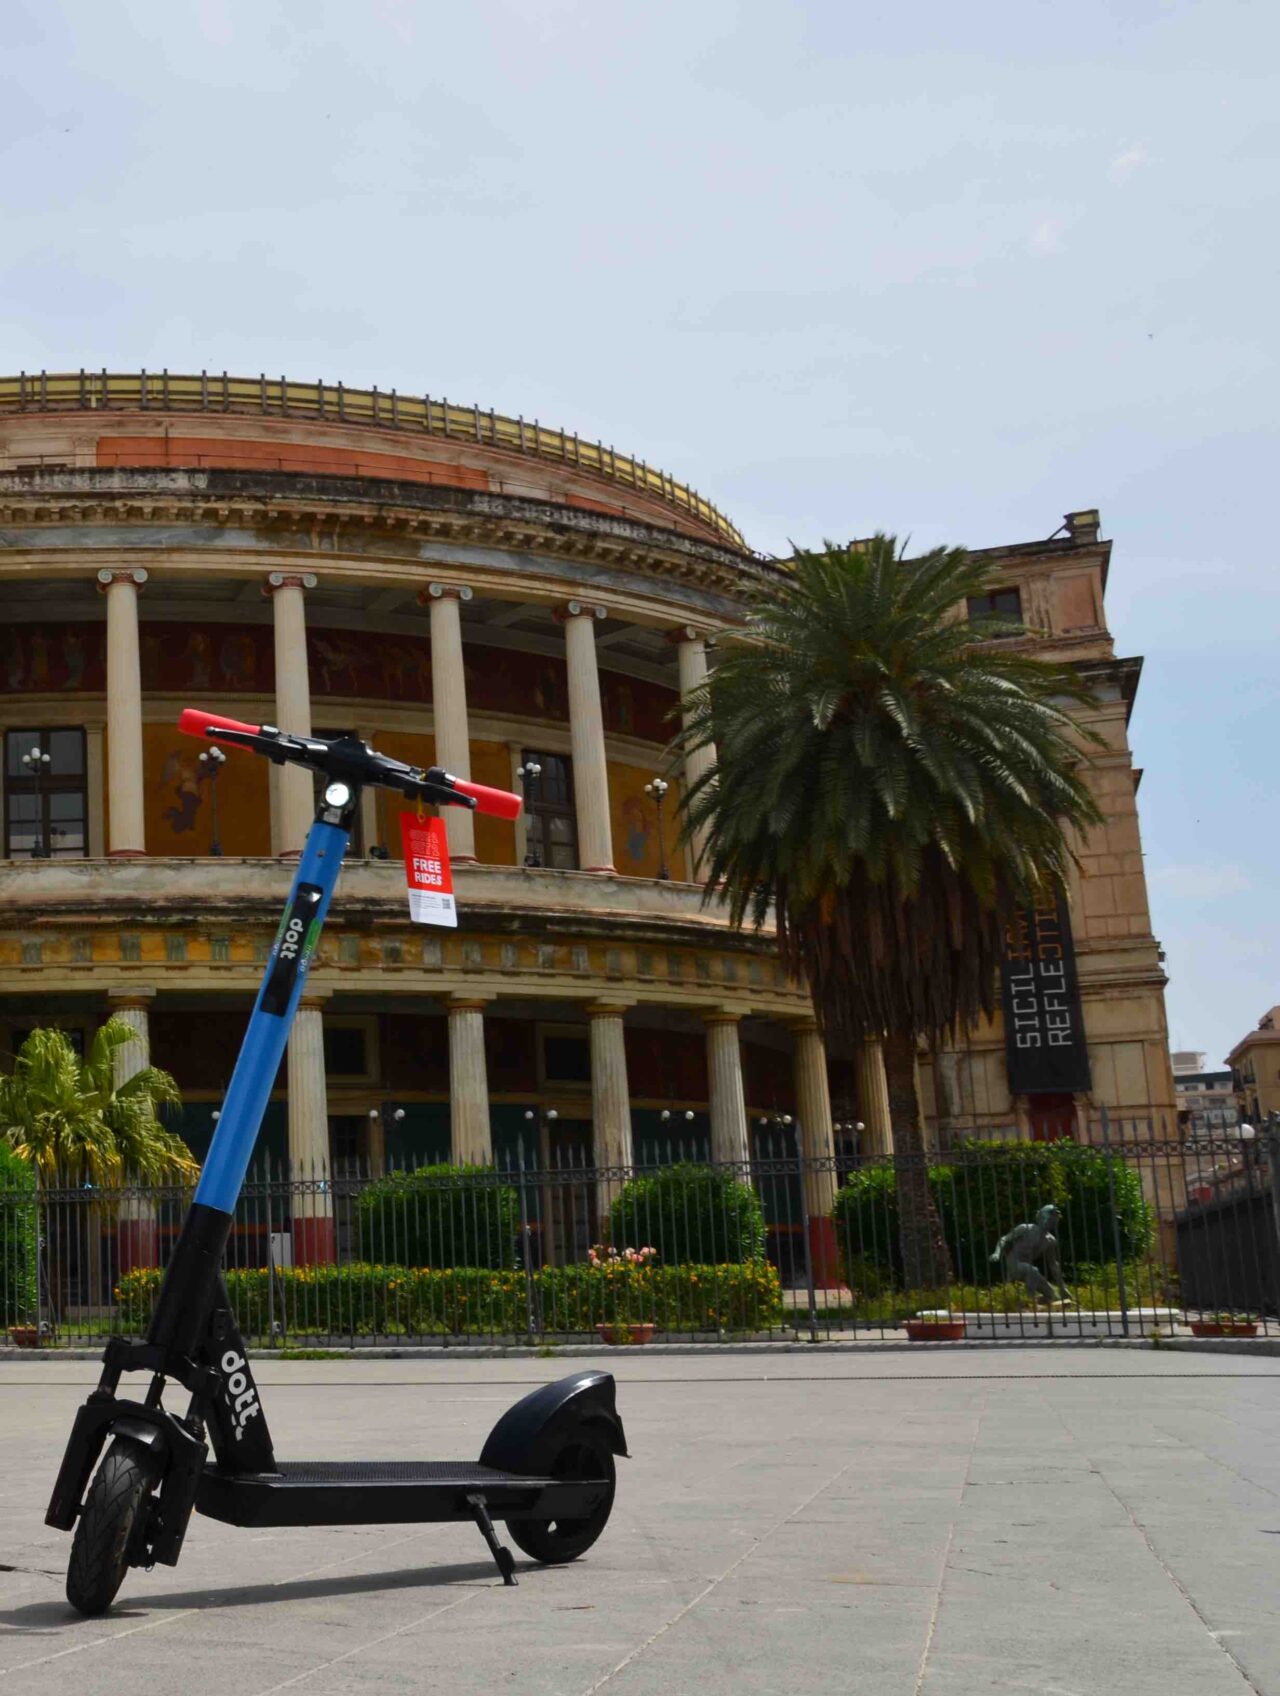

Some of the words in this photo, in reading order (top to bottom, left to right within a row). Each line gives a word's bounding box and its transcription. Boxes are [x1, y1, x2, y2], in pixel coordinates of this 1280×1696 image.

[412, 857, 442, 874] FREE
[414, 871, 443, 887] RIDES
[279, 918, 304, 960] dott
[220, 1350, 263, 1427] dott
